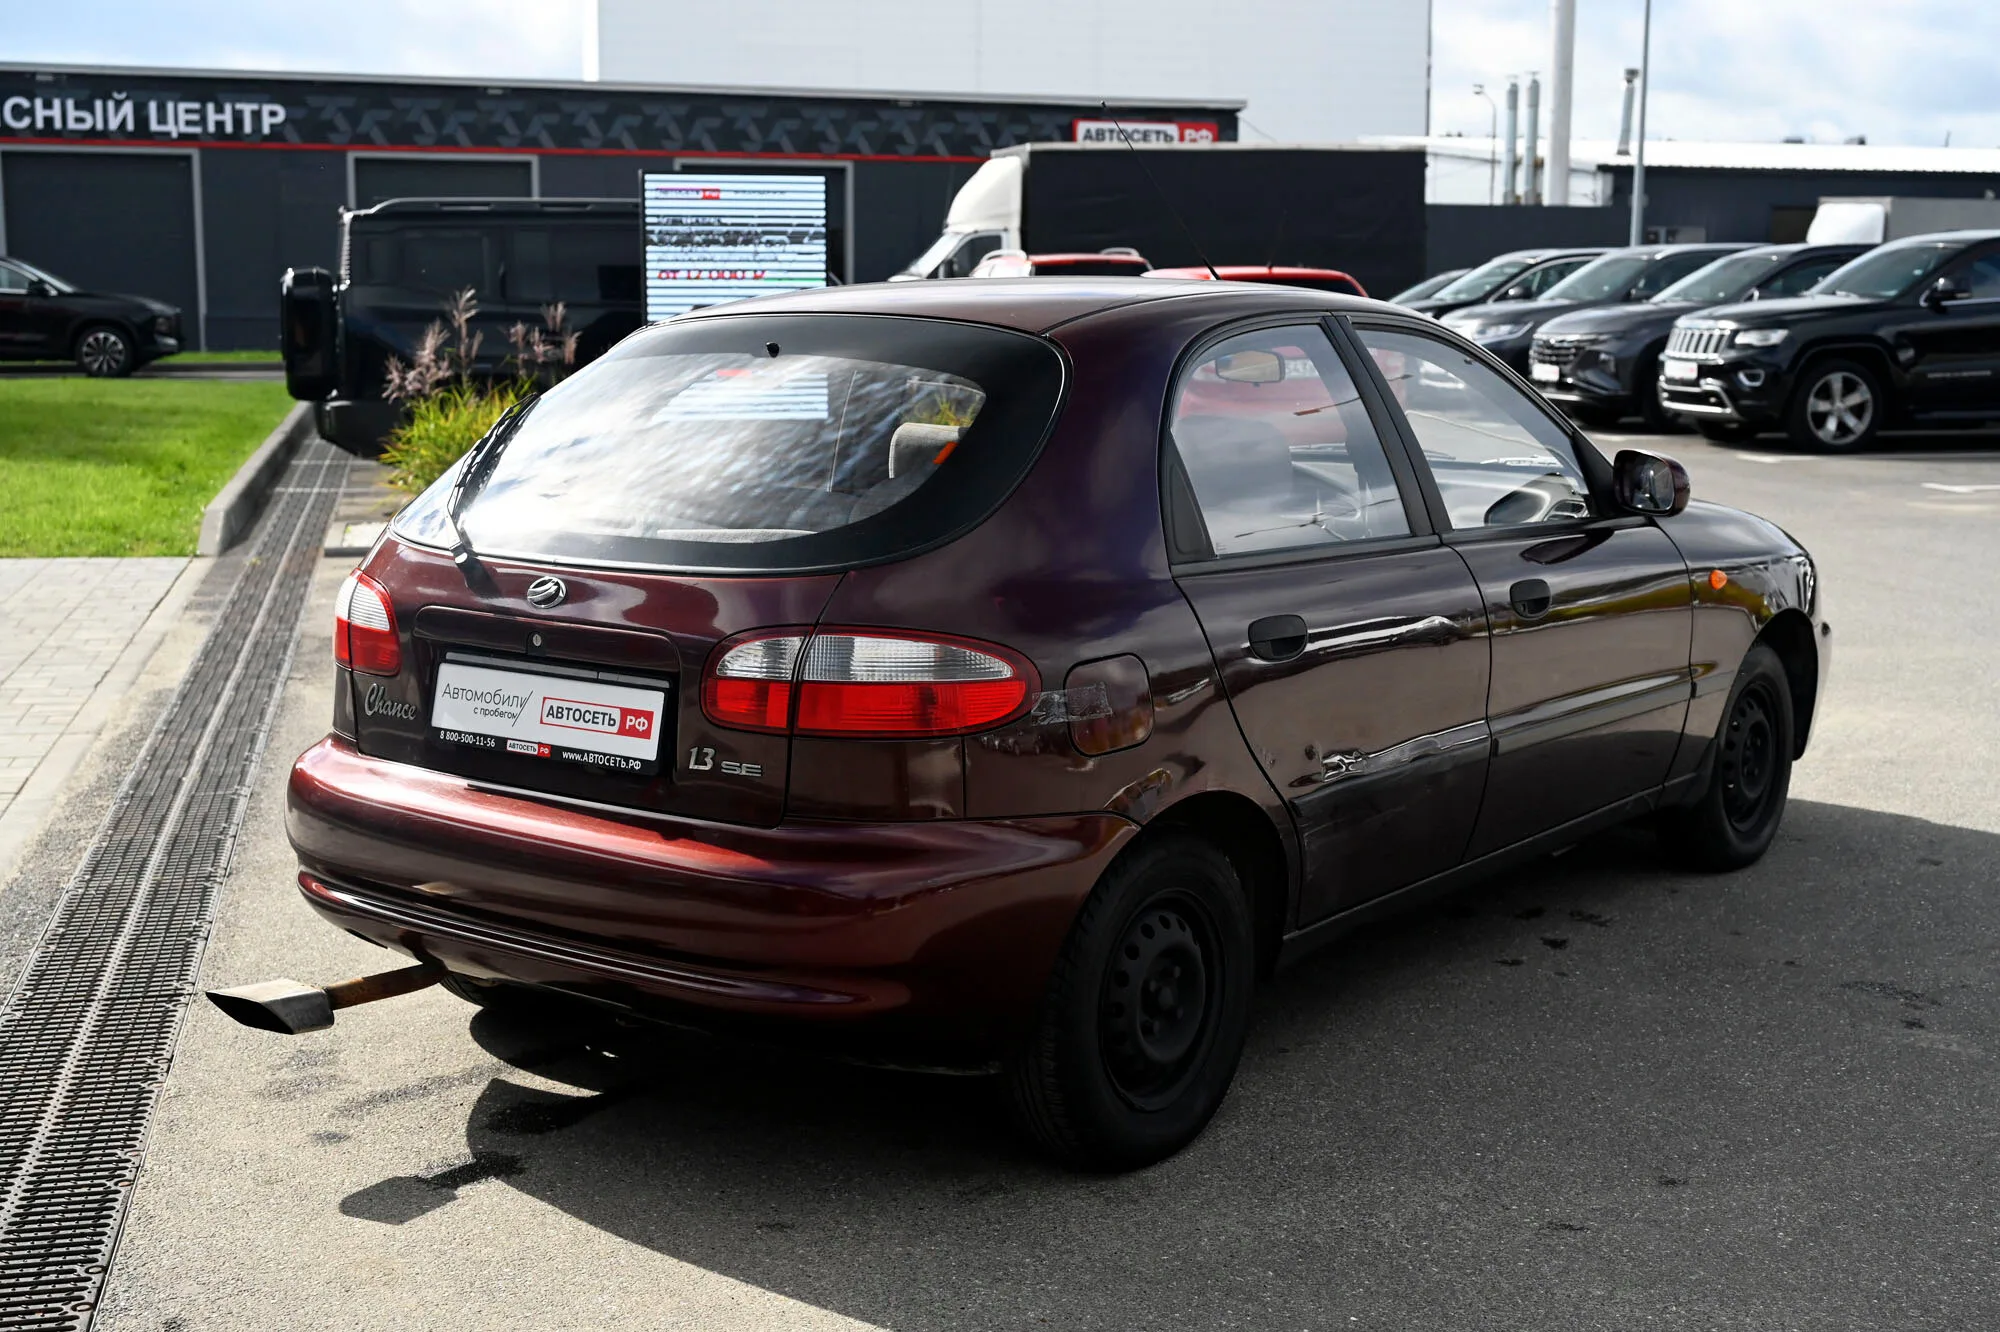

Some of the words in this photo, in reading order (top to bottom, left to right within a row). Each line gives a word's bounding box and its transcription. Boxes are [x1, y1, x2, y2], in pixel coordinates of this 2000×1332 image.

[149, 99, 286, 138] ЦЕНТР
[1083, 127, 1174, 142] АВТОСЕТЬ
[1183, 128, 1213, 142] РФ
[365, 683, 416, 720] Chance
[441, 682, 528, 709] Автомобили
[479, 707, 518, 720] пробегом
[546, 705, 617, 727] АВТОСЕТЬ
[625, 715, 649, 732] РФ
[440, 730, 445, 739] 8
[445, 731, 496, 748] 800-500-11-56
[508, 742, 537, 753] АВТОСЕТЬ
[539, 746, 550, 754] РФ
[562, 751, 642, 770] www.АВТОСЕТЬ.РФ
[721, 761, 762, 777] SE
